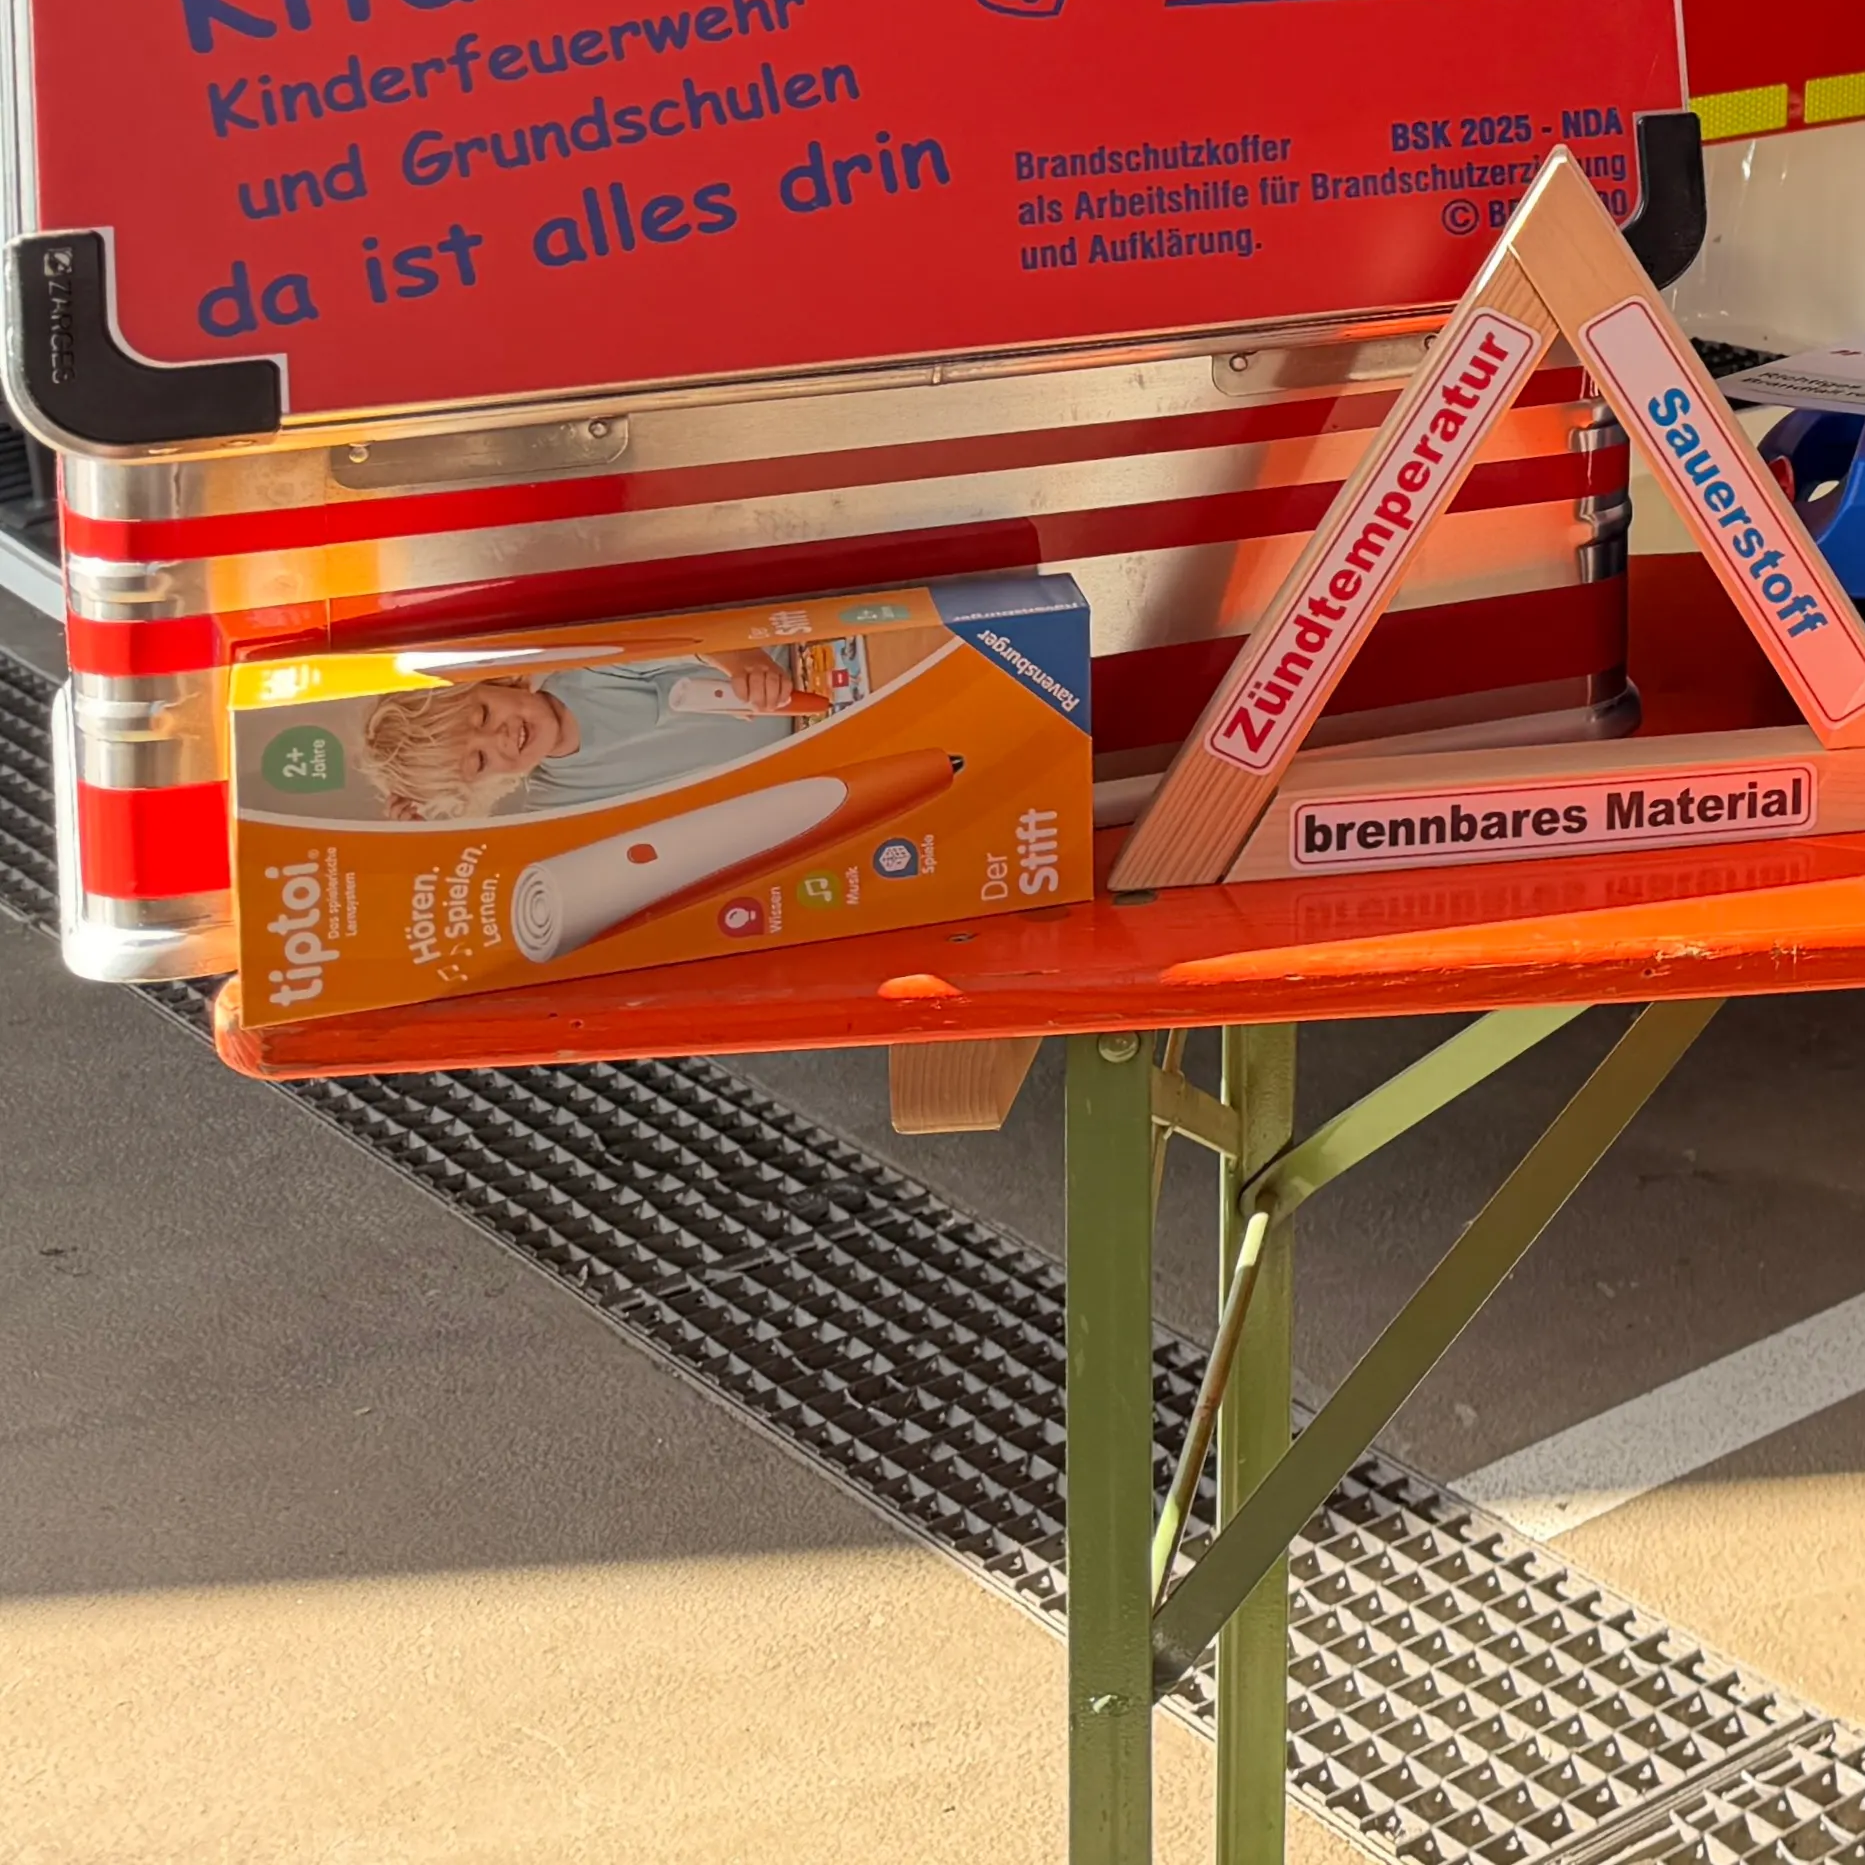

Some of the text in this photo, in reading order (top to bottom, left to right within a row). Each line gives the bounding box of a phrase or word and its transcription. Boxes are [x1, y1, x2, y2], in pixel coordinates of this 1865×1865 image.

[238, 62, 860, 221] und Grundschulen
[1014, 135, 1292, 182] Brandschutzkoffer
[1391, 107, 1624, 151] BSK 2025 NDA
[198, 131, 951, 337] da ist alles drin
[1018, 192, 1068, 228] als
[1073, 179, 1250, 224] Arbeitshilfe
[1259, 173, 1301, 208] für
[1020, 222, 1264, 270] und Aufklärung.
[1223, 330, 1511, 754] Zündtemperatur
[1647, 386, 1830, 639] Sauerstoff
[975, 629, 1081, 713] Ravensburger
[283, 747, 308, 778] 2+
[311, 739, 326, 779] Jahre
[1017, 807, 1059, 896] Stift
[1303, 777, 1804, 856] brennbares Material
[846, 864, 859, 905] Musik
[922, 833, 936, 875] Spiele
[981, 852, 1009, 902] Der
[327, 845, 342, 940] Das spielerische
[345, 871, 360, 937] Lernsystem
[409, 865, 442, 966] Hören.
[442, 843, 488, 940] Spielen.
[480, 872, 502, 948] Lernen.
[769, 885, 783, 934] Wissen
